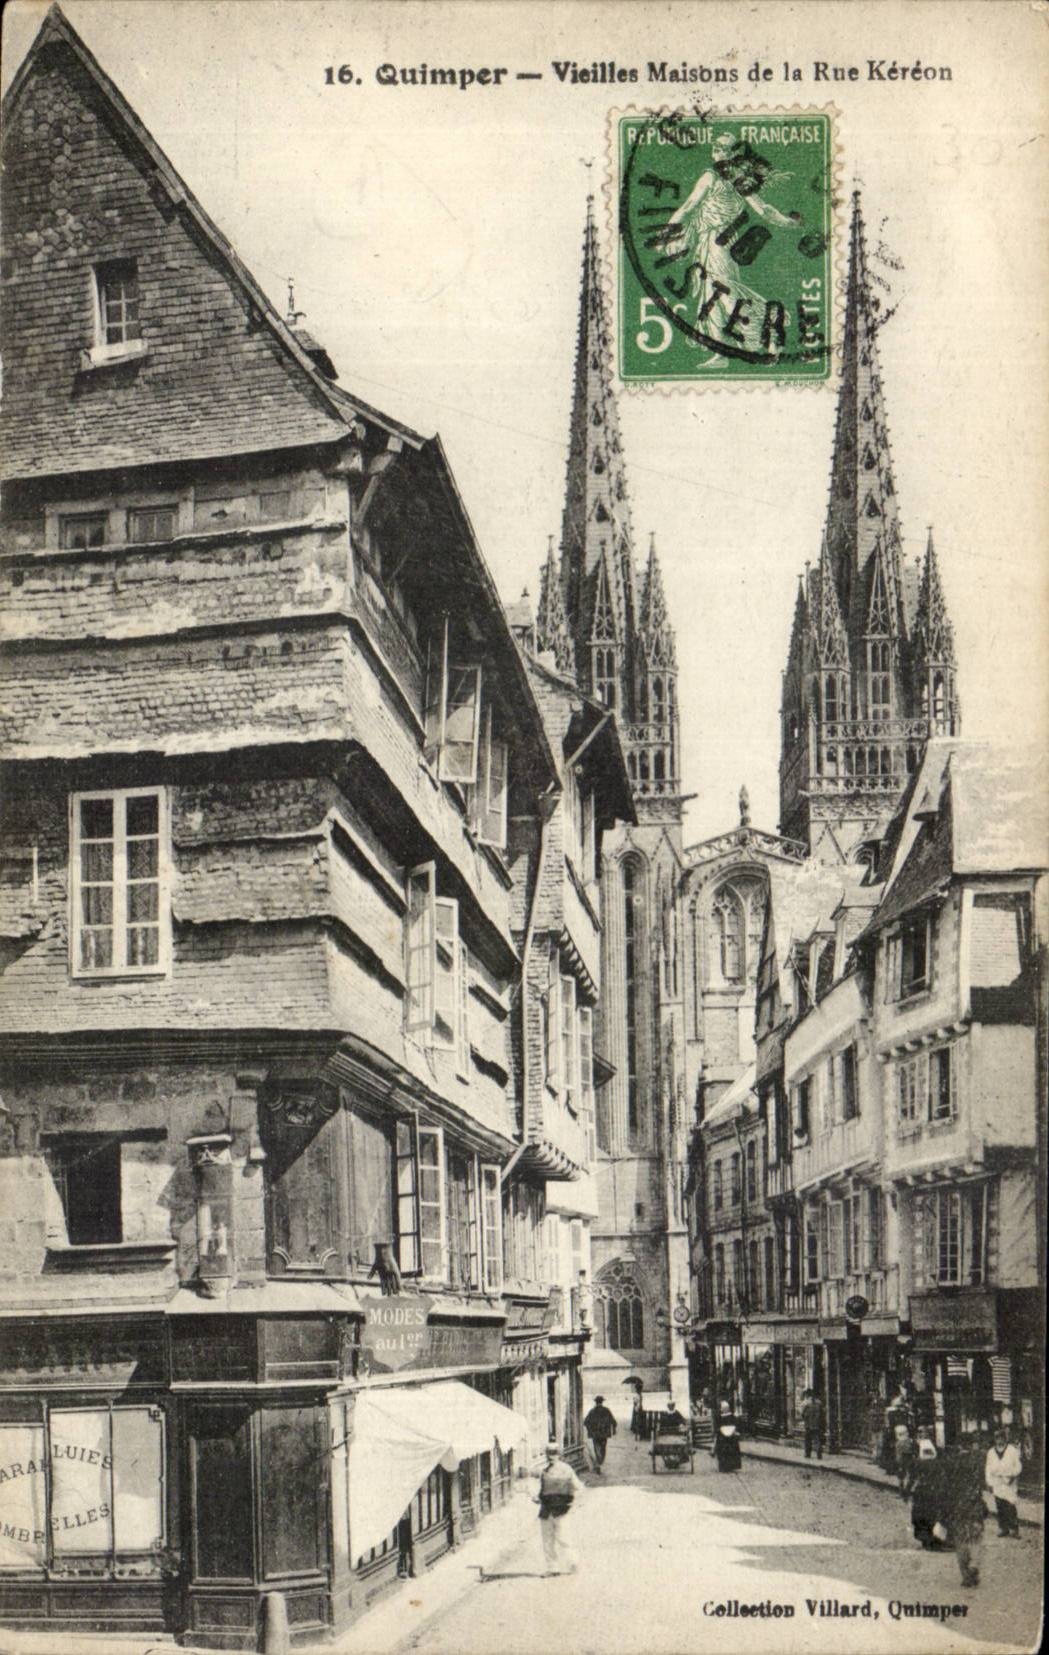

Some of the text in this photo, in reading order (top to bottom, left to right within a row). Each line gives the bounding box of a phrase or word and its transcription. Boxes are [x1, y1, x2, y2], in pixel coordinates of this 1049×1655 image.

[740, 124, 822, 147] FRANÇAISE
[369, 1307, 426, 1327] MODES
[375, 1337, 397, 1351] au
